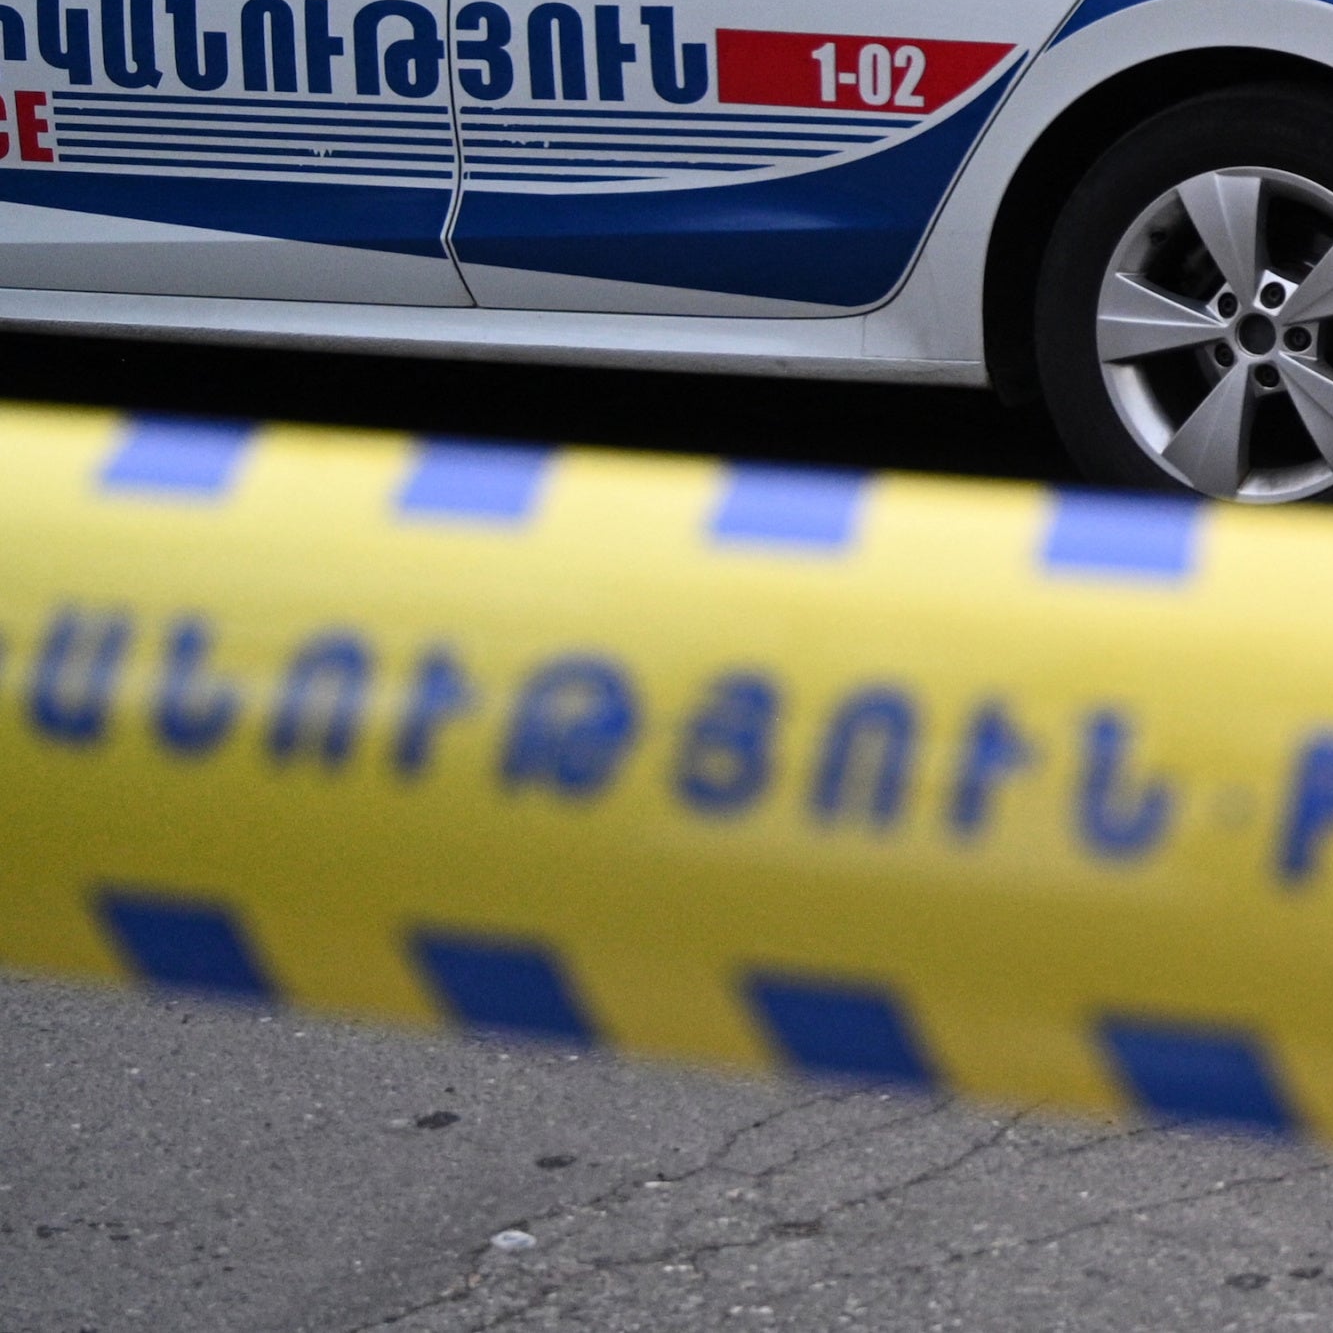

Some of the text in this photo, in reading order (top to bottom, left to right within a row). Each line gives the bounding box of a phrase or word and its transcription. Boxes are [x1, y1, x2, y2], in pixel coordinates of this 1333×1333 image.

[810, 40, 926, 109] 1-02
[0, 90, 55, 163] E
[0, 598, 1178, 858] ԱՆՈՒԹՅՈՒՆ
